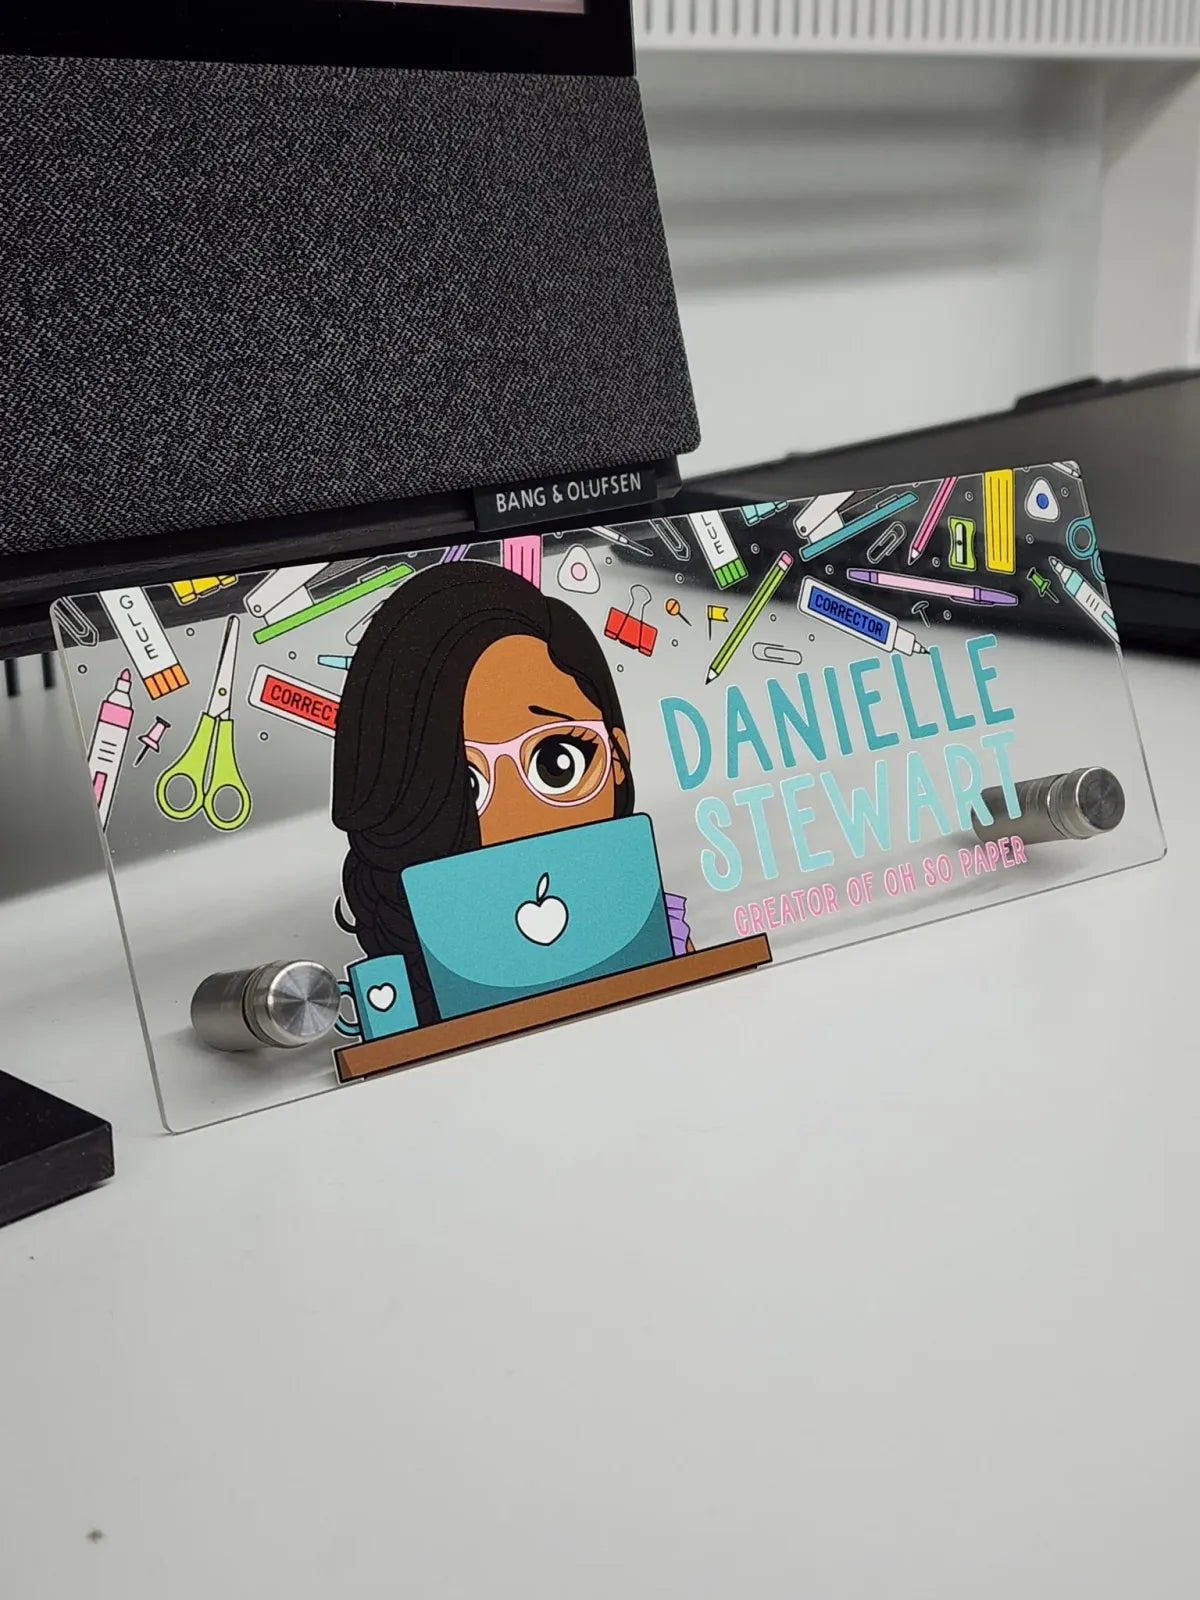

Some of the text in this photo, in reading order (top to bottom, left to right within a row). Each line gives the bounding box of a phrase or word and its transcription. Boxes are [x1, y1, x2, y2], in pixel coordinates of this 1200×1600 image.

[496, 472, 642, 513] BANG & OLUFSEN
[700, 513, 725, 555] LUE
[119, 594, 159, 660] GLUE
[814, 594, 884, 637] CORRECTOR
[659, 633, 1015, 791] DANIELLE
[695, 730, 1022, 892] STEWART
[734, 836, 1027, 936] CREATOR OF OH SO PAPER
